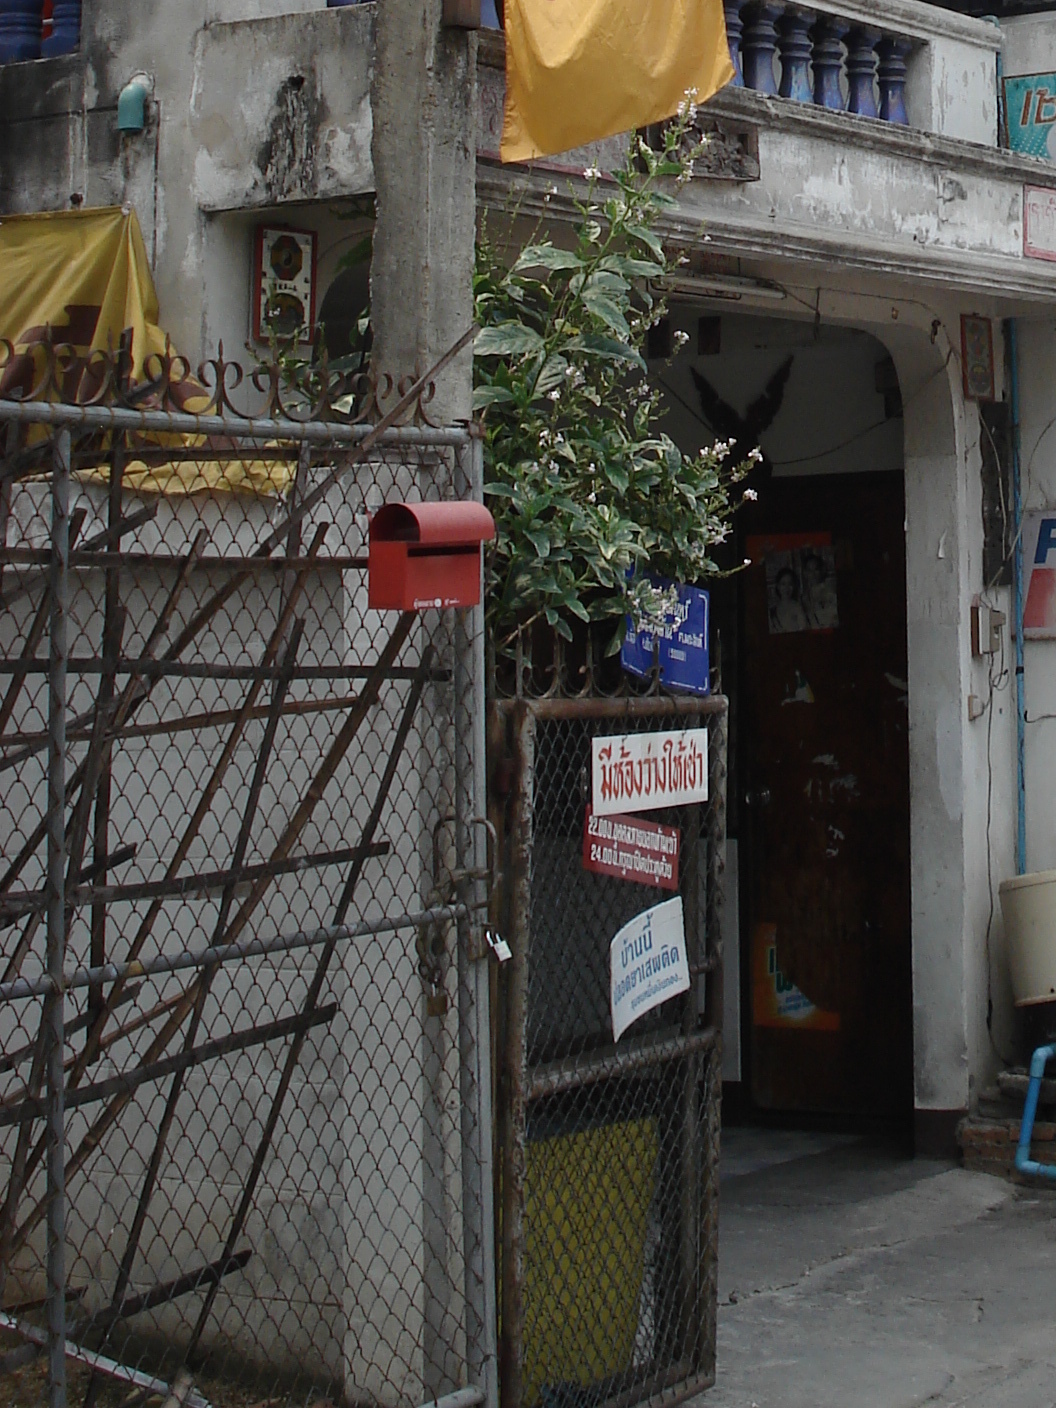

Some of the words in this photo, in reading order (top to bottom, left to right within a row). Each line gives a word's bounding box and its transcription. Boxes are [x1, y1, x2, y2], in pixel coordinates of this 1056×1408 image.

[598, 739, 703, 801] มีห้องว่างให้เช่า
[620, 912, 654, 968] บ้านนี้
